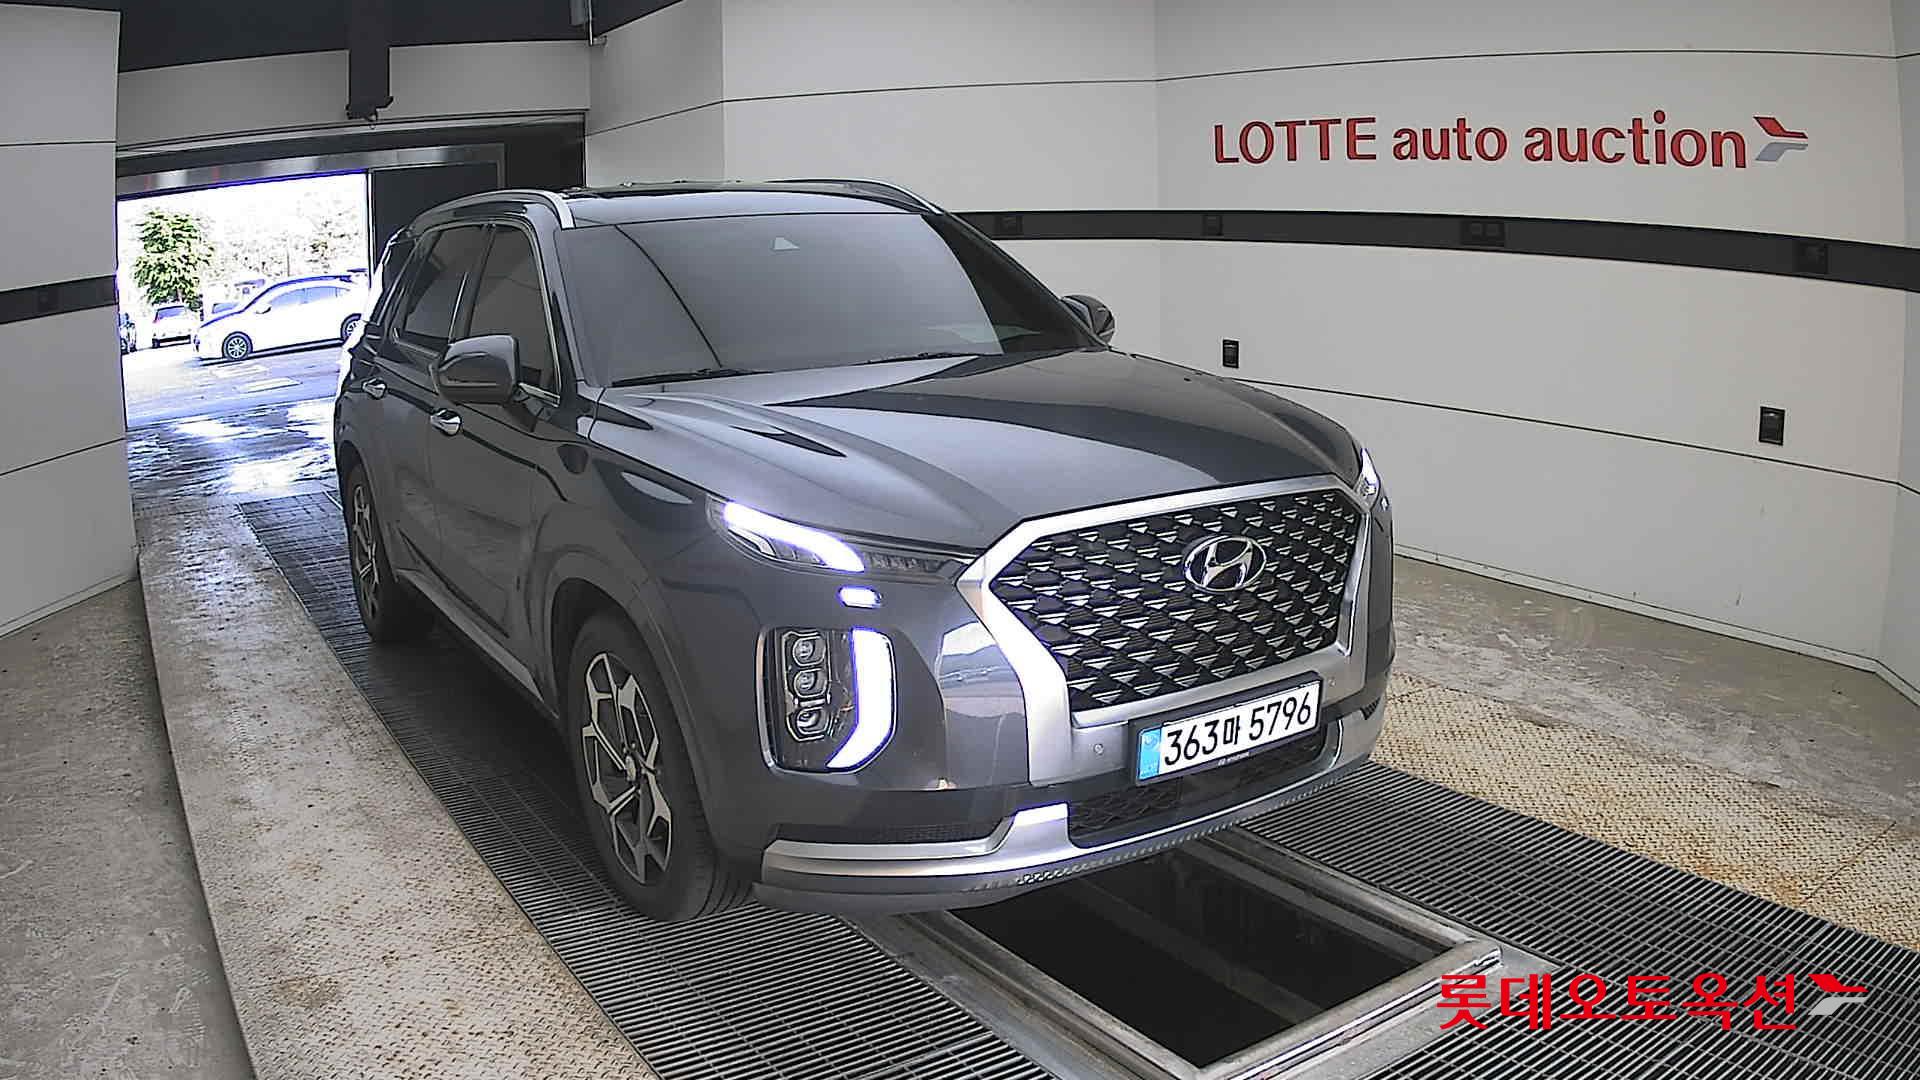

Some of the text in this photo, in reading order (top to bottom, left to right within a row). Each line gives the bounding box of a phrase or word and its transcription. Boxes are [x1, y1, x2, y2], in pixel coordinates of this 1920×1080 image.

[1213, 110, 1747, 169] LOTTE auto auction
[1164, 691, 1312, 766] 363마 5796
